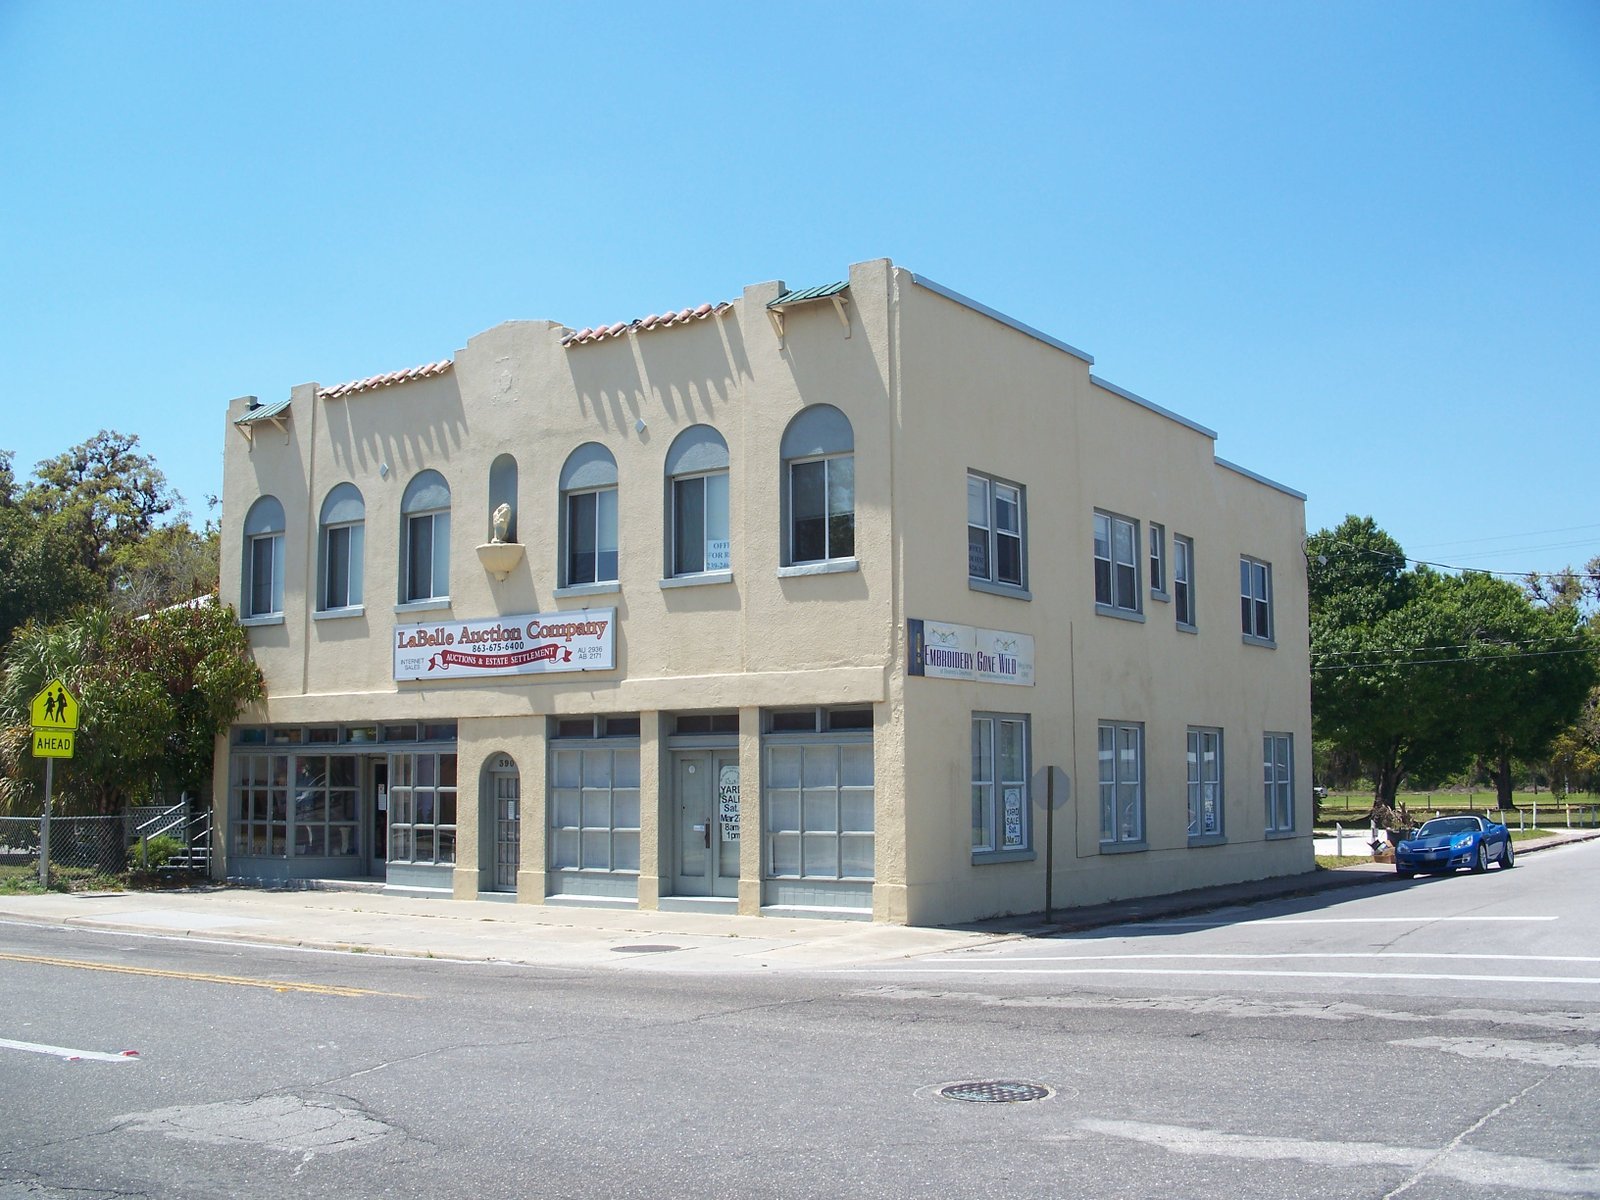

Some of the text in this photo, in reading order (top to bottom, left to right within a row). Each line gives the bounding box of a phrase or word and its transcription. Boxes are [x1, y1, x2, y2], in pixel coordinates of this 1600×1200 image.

[398, 620, 608, 648] LaBelle Auction Company
[472, 641, 525, 652] 863-675-6400
[400, 657, 424, 665] INTERNET
[446, 653, 476, 665] AUCTIONS
[485, 657, 508, 665] ESTATE
[511, 647, 555, 664] SETTLEMENT
[925, 644, 975, 670] EMBROIDERY
[977, 651, 996, 673] GONE
[998, 653, 1017, 675] WILD
[36, 737, 71, 750] AHEAD
